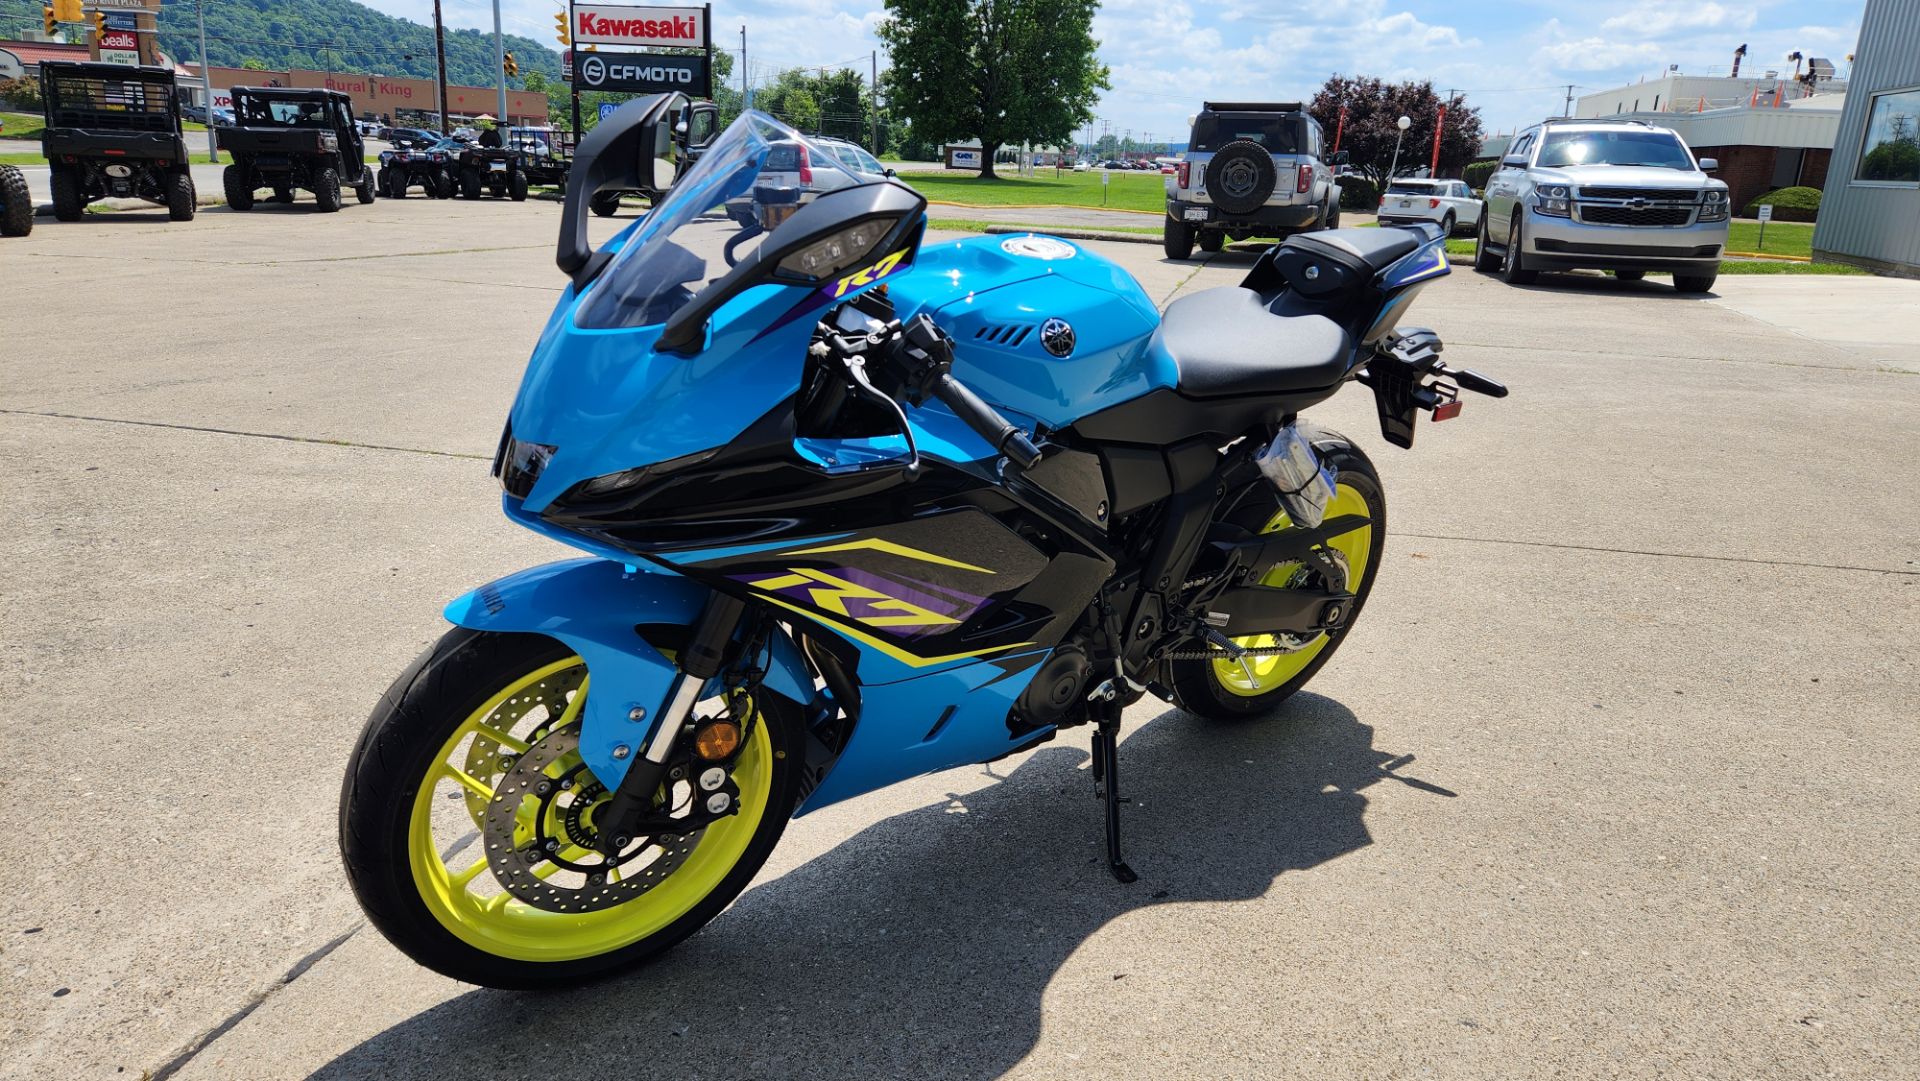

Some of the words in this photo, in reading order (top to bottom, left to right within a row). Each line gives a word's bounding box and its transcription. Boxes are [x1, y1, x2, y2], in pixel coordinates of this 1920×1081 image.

[579, 12, 696, 39] Kawasaki
[101, 33, 135, 48] bealls
[609, 65, 692, 83] CFMOTO
[324, 79, 366, 93] Rural
[380, 83, 412, 98] King
[213, 96, 231, 107] XP
[834, 246, 911, 298] R7
[748, 567, 964, 627] R7
